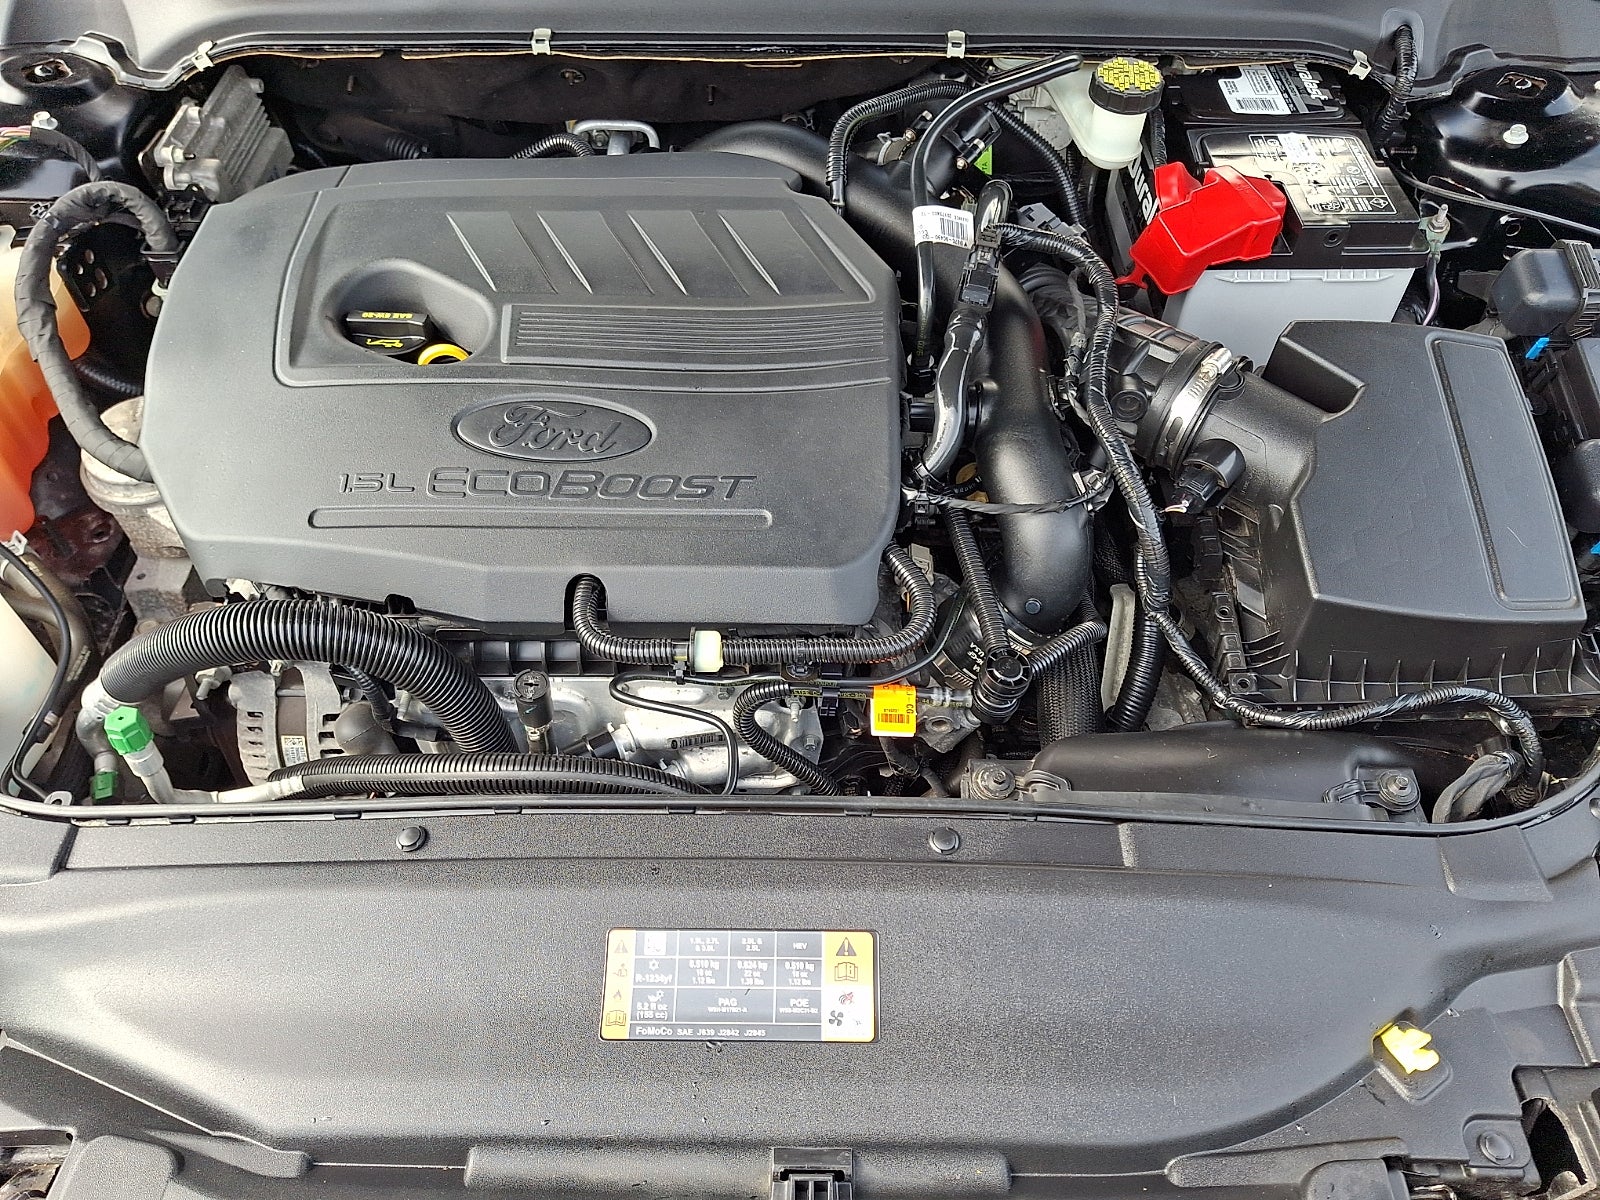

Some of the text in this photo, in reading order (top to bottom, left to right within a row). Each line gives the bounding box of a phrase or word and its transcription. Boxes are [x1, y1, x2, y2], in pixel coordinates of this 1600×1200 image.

[489, 404, 622, 453] Ford
[340, 472, 415, 493] 1.5L
[718, 997, 738, 1007] PAG
[790, 998, 810, 1007] POE
[635, 1026, 673, 1036] FoMoCo
[677, 1028, 694, 1036] SAE
